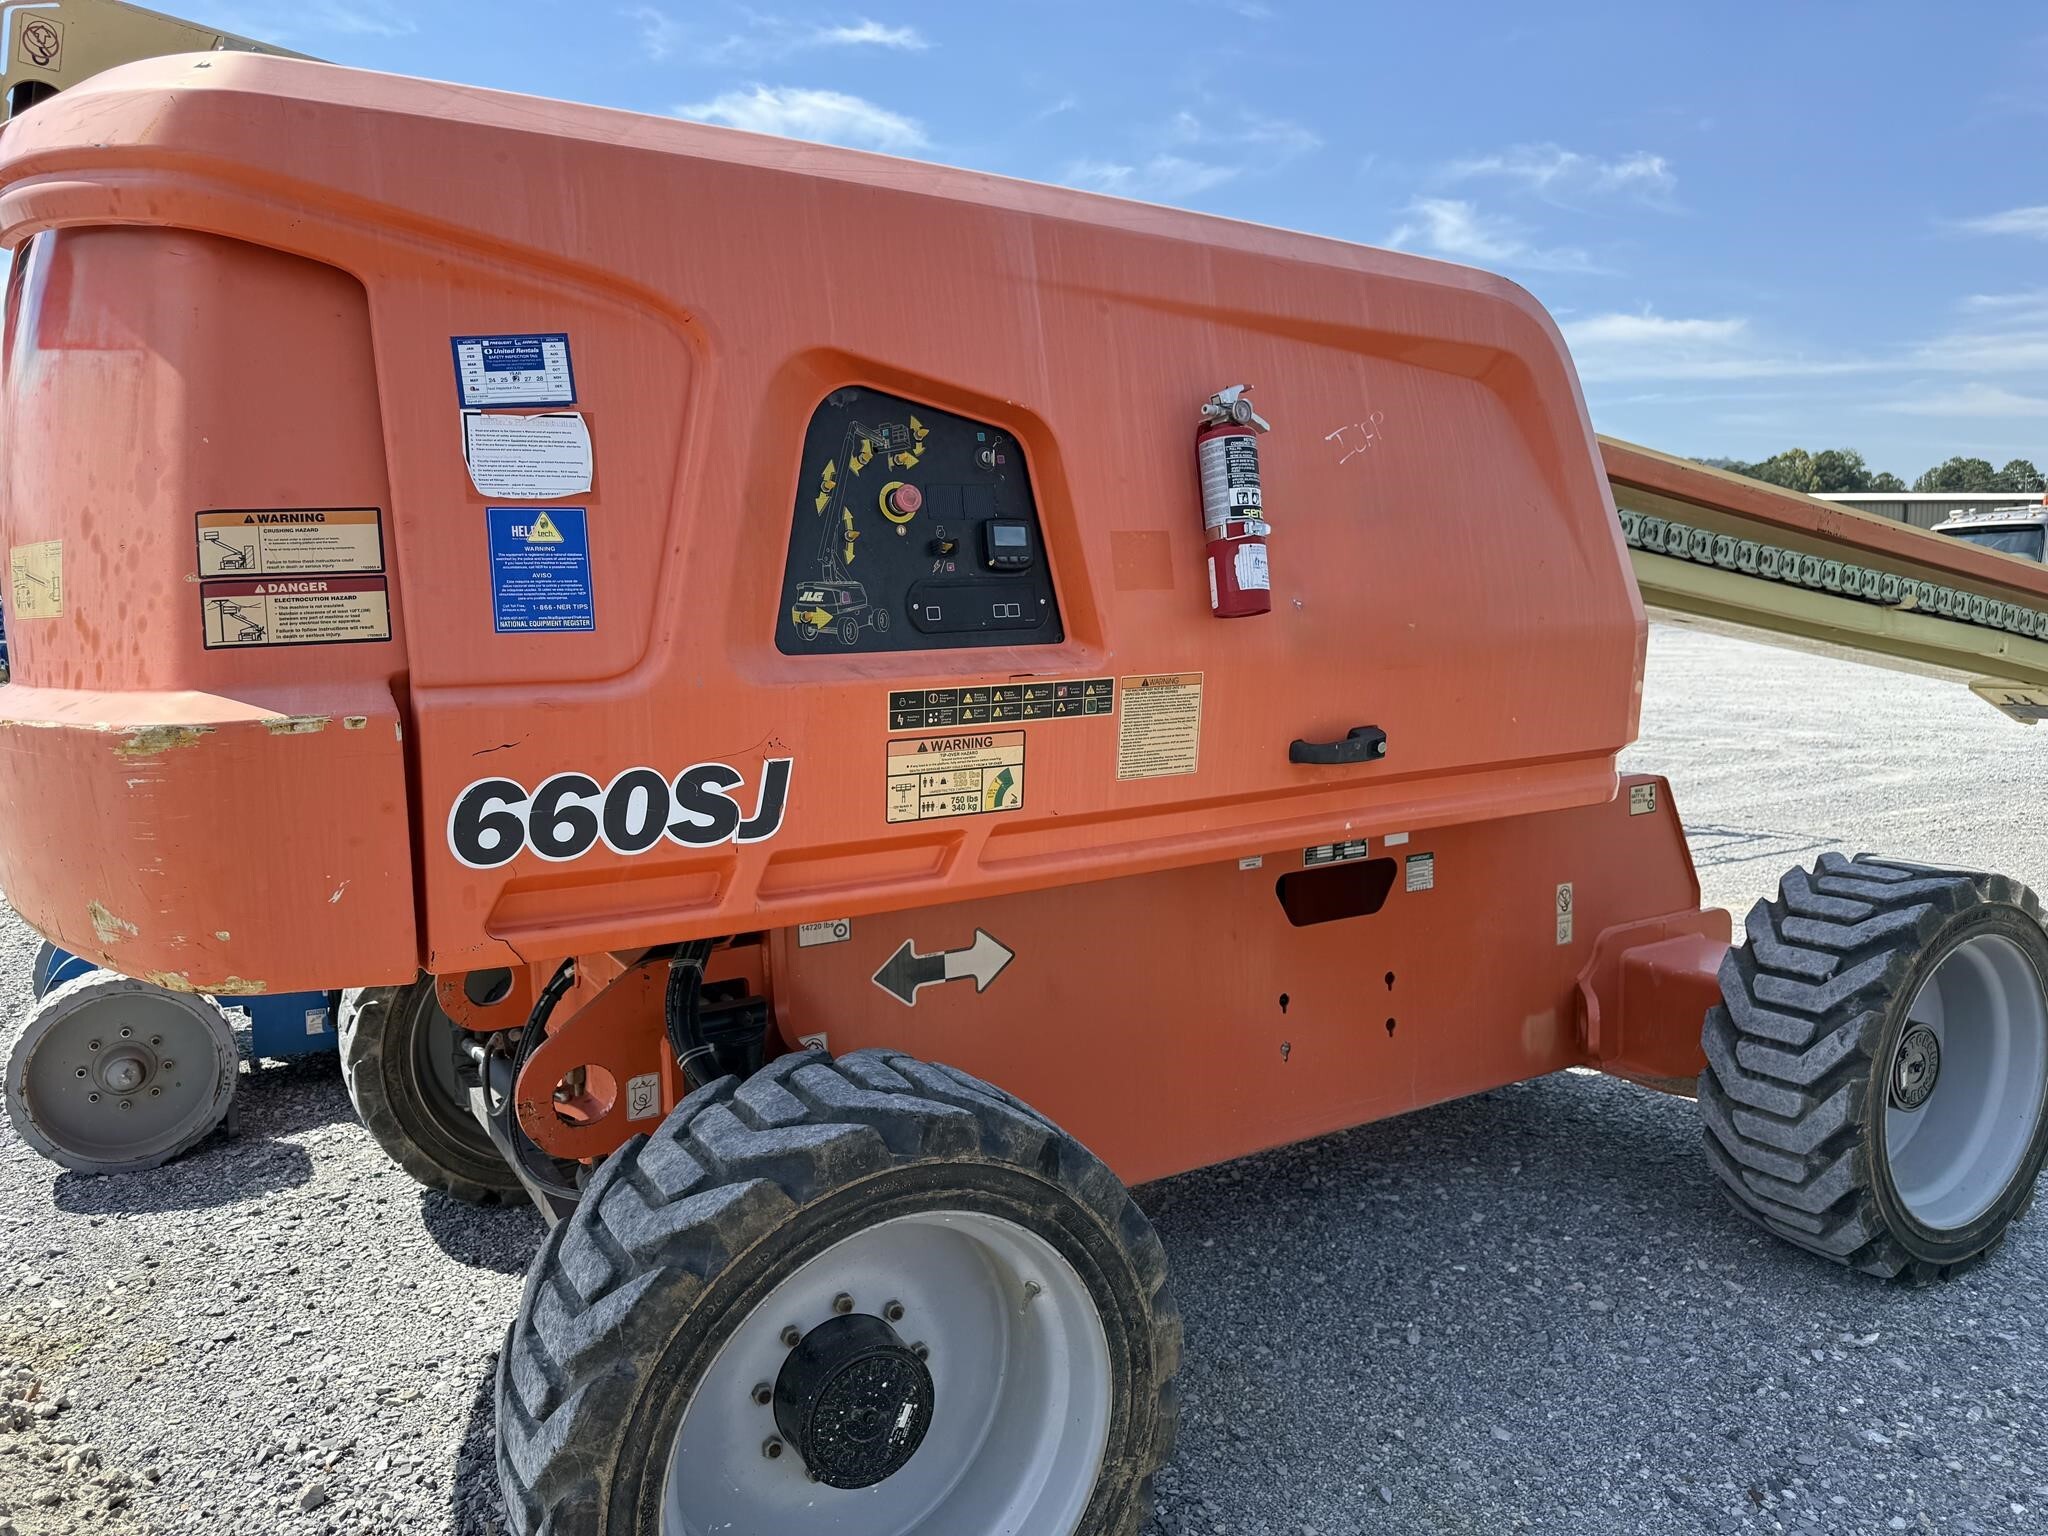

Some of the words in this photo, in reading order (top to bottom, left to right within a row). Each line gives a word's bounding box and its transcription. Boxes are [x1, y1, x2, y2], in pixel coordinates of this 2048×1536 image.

[257, 513, 325, 523] WARNING
[268, 582, 328, 593] DANGER
[1149, 677, 1180, 686] WARNING
[931, 736, 993, 751] WARNING
[950, 796, 964, 804] 750
[968, 803, 978, 811] kg
[449, 757, 793, 868] 660SJ
[802, 923, 822, 932] 14720
